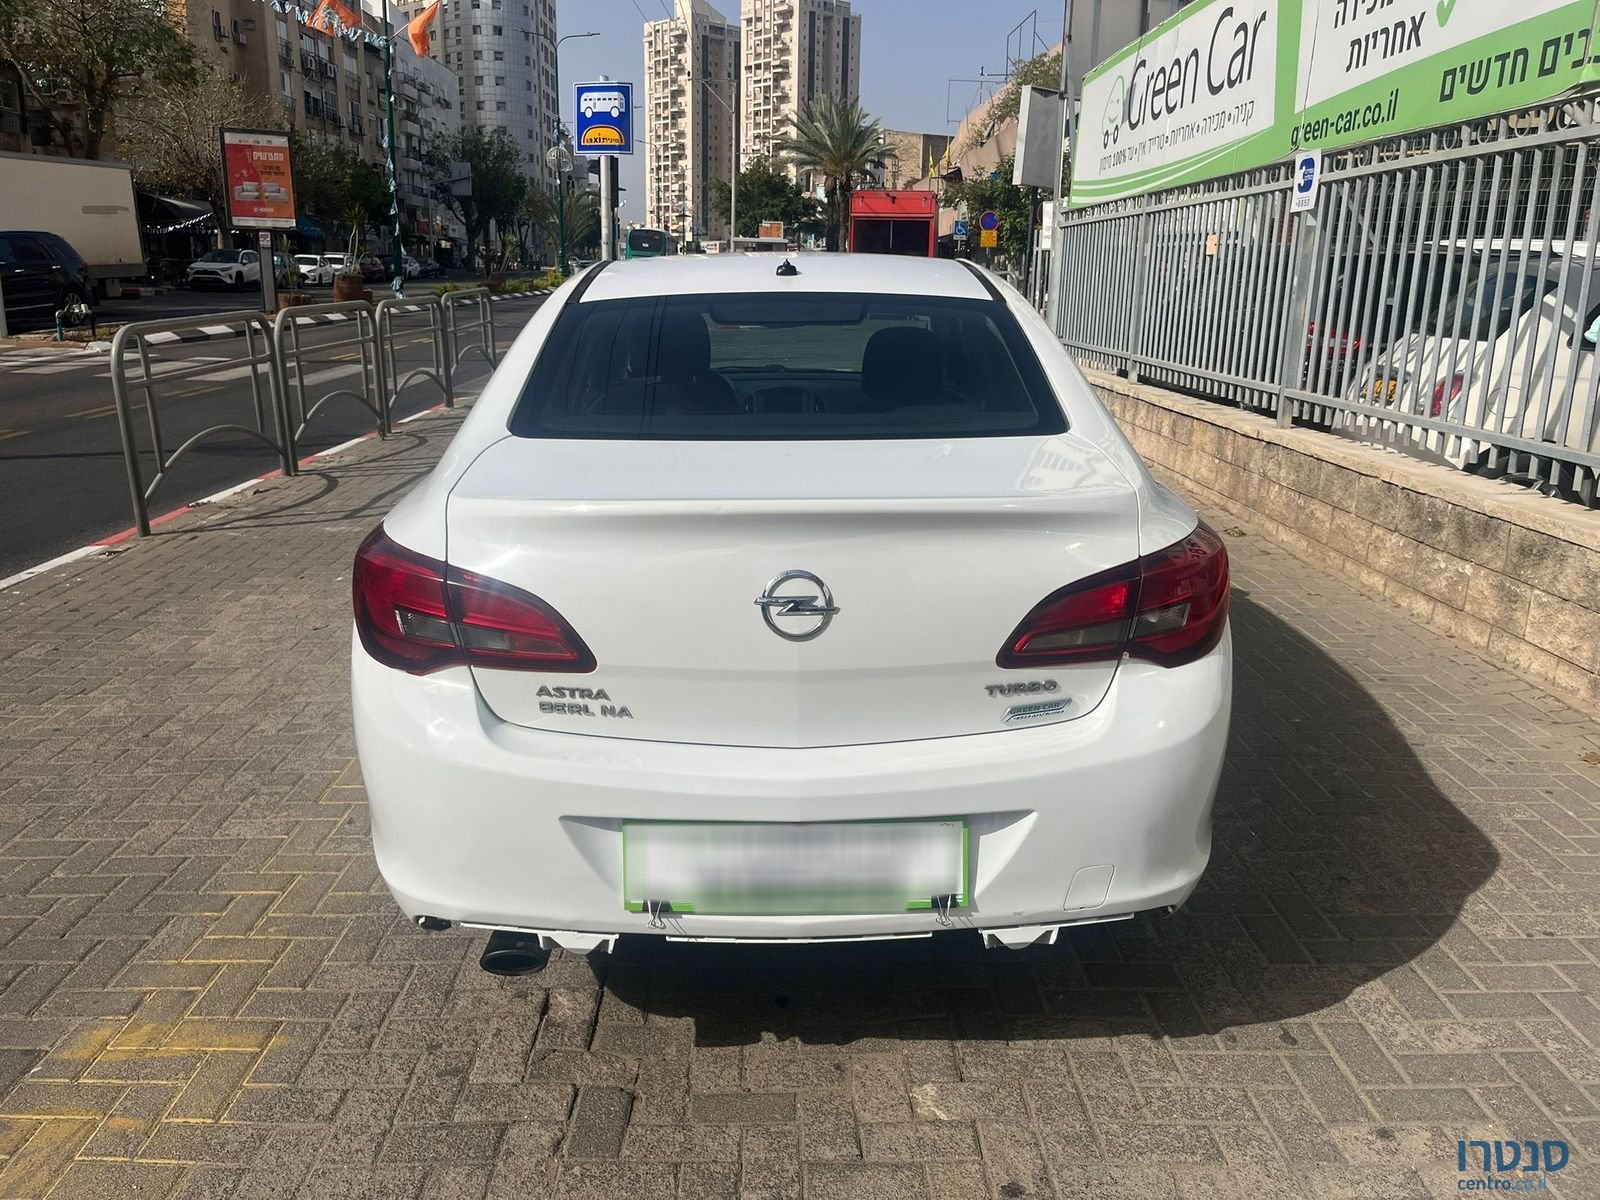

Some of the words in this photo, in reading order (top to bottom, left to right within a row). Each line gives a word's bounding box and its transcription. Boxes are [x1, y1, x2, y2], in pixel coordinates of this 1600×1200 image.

[1345, 11, 1426, 73] אחריות
[1537, 28, 1600, 78] בים
[1128, 48, 1199, 131] Green
[1207, 6, 1267, 96] Car
[1439, 47, 1529, 102] חדשים
[1200, 110, 1226, 136] מכירה
[1232, 100, 1255, 127] קניה
[1168, 121, 1196, 147] אחריות
[536, 685, 611, 701] ASTRA
[984, 679, 1058, 697] TURBO
